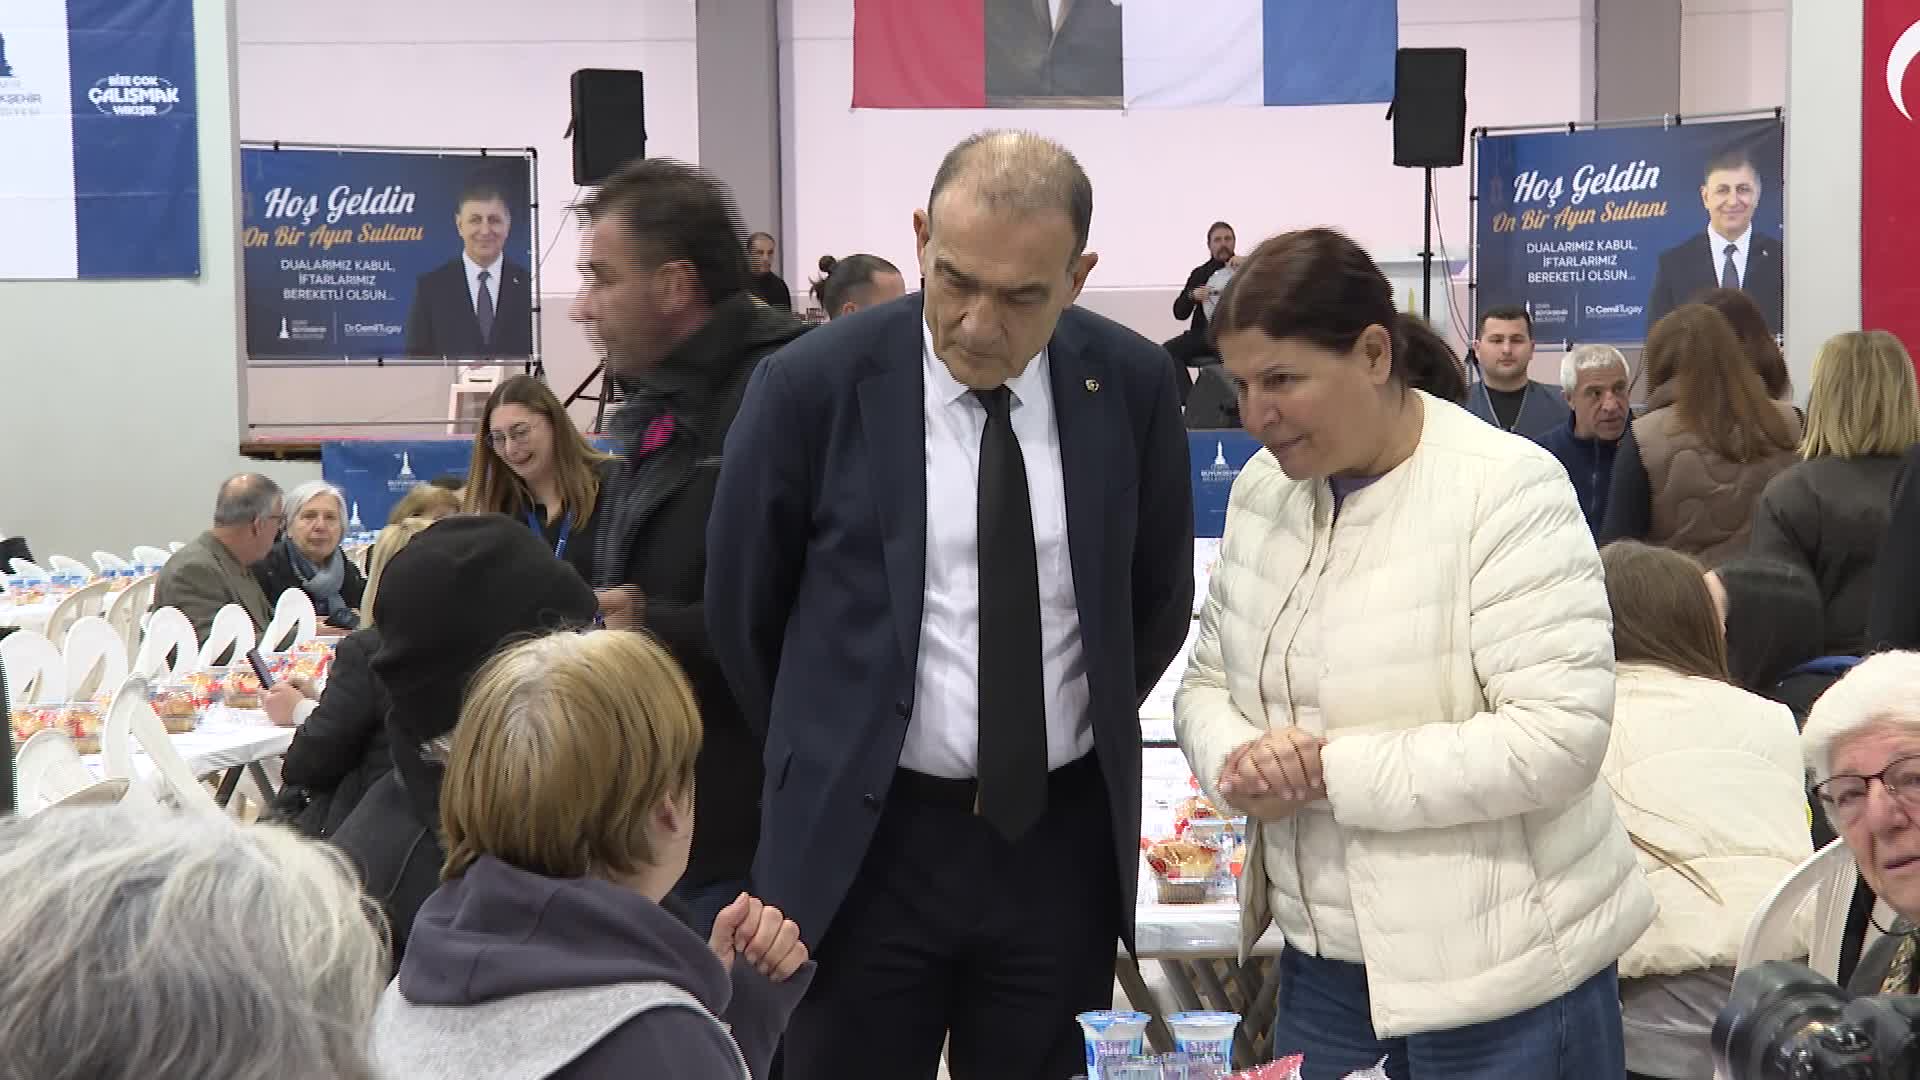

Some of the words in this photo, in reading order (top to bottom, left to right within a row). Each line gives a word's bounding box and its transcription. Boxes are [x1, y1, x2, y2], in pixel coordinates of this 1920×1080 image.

[88, 88, 180, 104] ÇALIŞMAK
[1513, 170, 1563, 208] Hoş
[1571, 160, 1660, 205] Geldin
[264, 187, 319, 225] Hoş
[326, 185, 416, 224] Geldin
[1492, 212, 1516, 232] On
[1521, 208, 1550, 230] Bir
[1554, 205, 1596, 232] Ayın
[1600, 200, 1668, 223] Sultanı
[242, 226, 269, 247] On
[274, 225, 304, 246] Bir
[308, 224, 353, 250] Ayın
[357, 222, 424, 243] Sultanı
[1527, 240, 1594, 253] DUALARIMIZ
[280, 259, 352, 271] DUALARIMIZ
[1543, 254, 1618, 268] İFTARLARIMIZ
[299, 272, 376, 285] İFTARLARIMIZ
[1528, 268, 1585, 283] BEREKETLİ
[283, 288, 344, 301] BEREKETLİ
